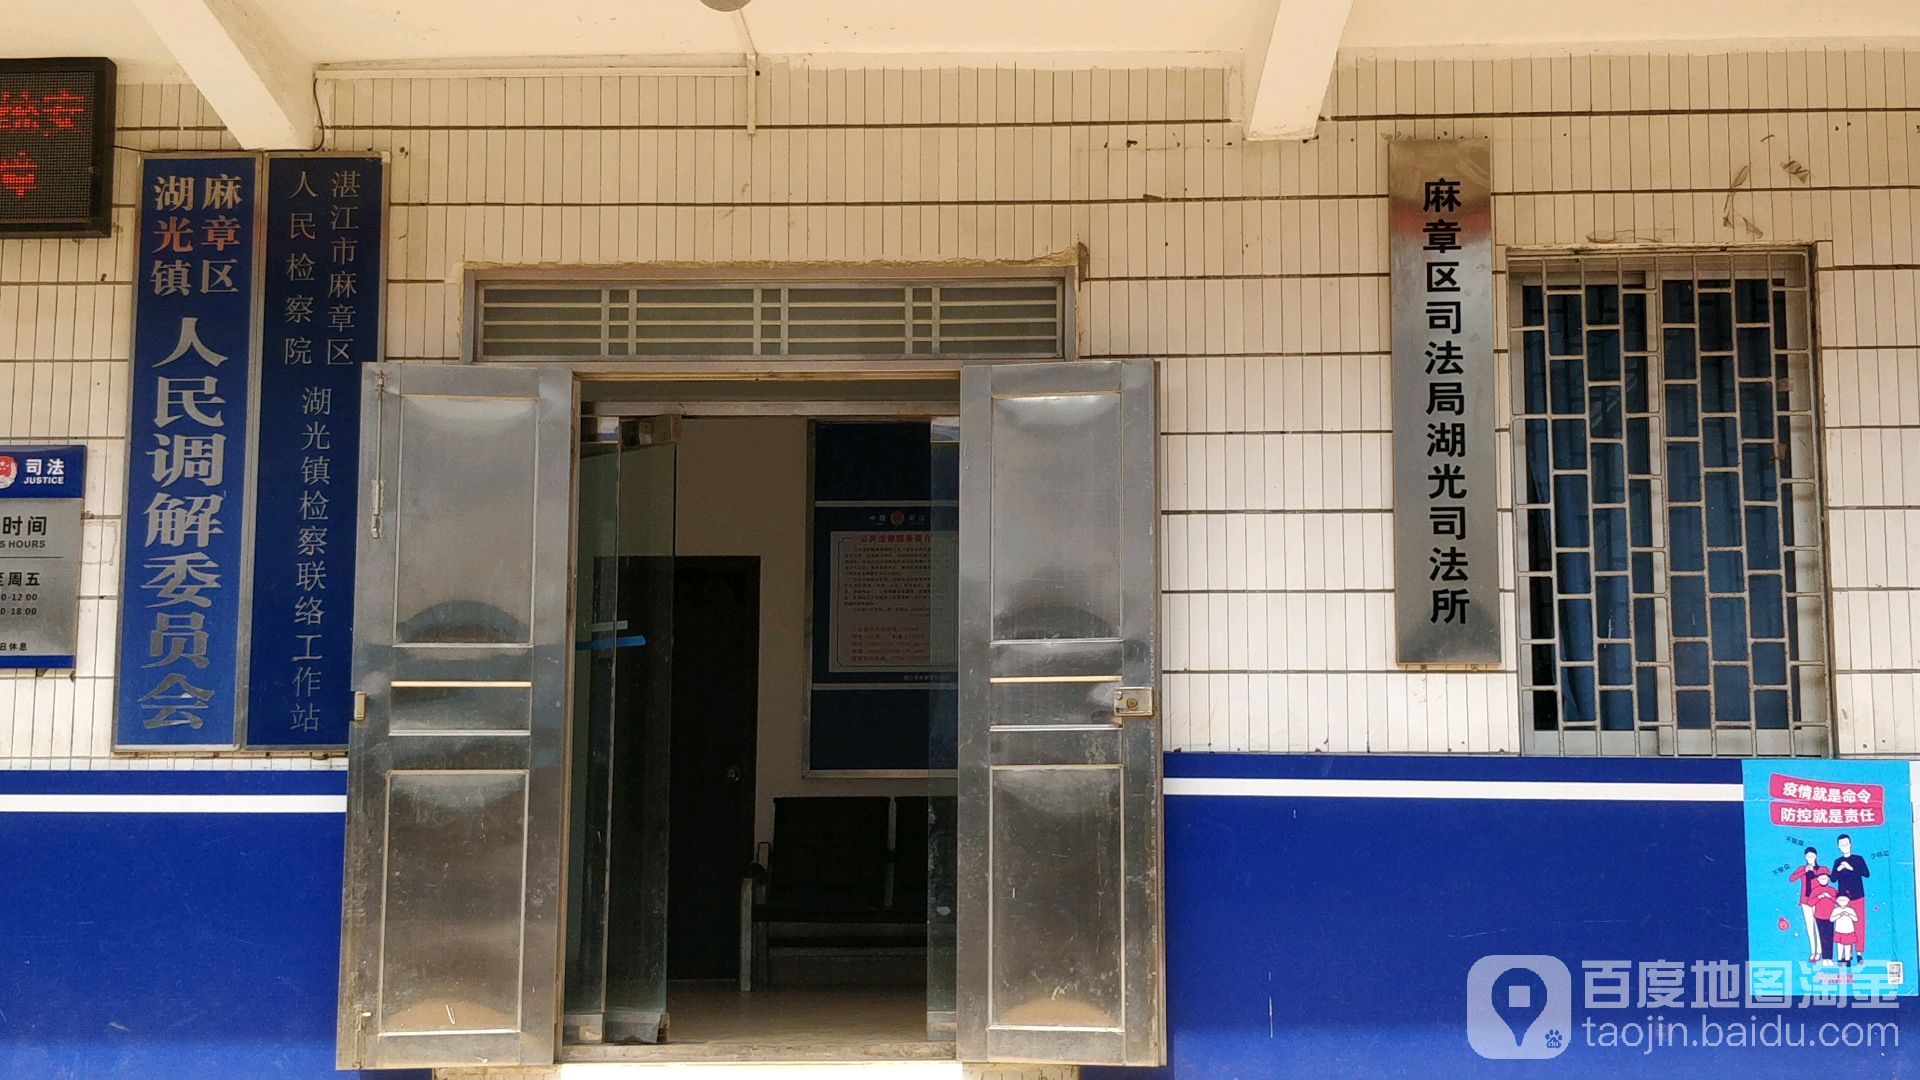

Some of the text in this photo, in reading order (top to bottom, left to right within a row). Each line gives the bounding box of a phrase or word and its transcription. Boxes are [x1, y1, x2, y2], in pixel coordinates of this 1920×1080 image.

[149, 175, 196, 297] 湖光镇
[200, 173, 243, 295] 麻章区
[284, 170, 318, 366] 人民检察院
[327, 170, 361, 366] 湛江市麻章区
[1422, 177, 1470, 625] 麻章区司法局湖光司法所
[2, 515, 47, 536] 时间
[23, 476, 65, 485] JUSTICE
[25, 458, 65, 475] 司法
[137, 316, 229, 730] 人民调解委员会
[8, 540, 46, 549] HOURS
[290, 386, 333, 733] 湖光镇检察联络工作站
[1780, 807, 1876, 824] 防控就是责任
[1782, 782, 1872, 804] 疫情就是命令
